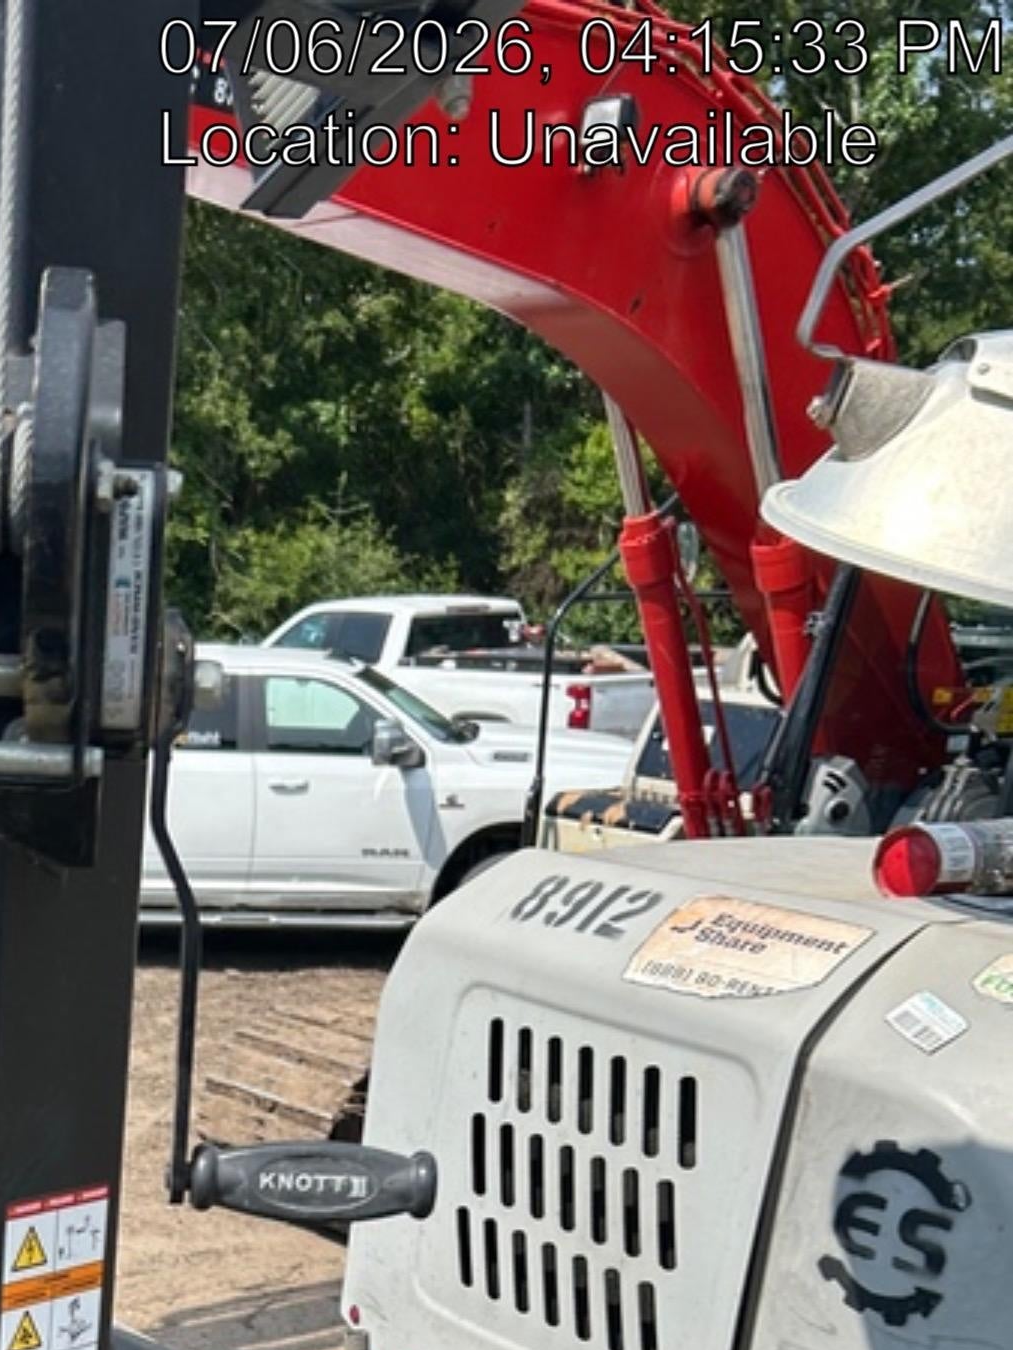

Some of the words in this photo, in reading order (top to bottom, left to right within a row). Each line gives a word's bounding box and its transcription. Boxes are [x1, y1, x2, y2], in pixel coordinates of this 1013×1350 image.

[511, 874, 663, 940] 8912
[695, 927, 767, 955] Share
[710, 911, 850, 957] Equipment
[258, 1172, 348, 1194] KNOTT
